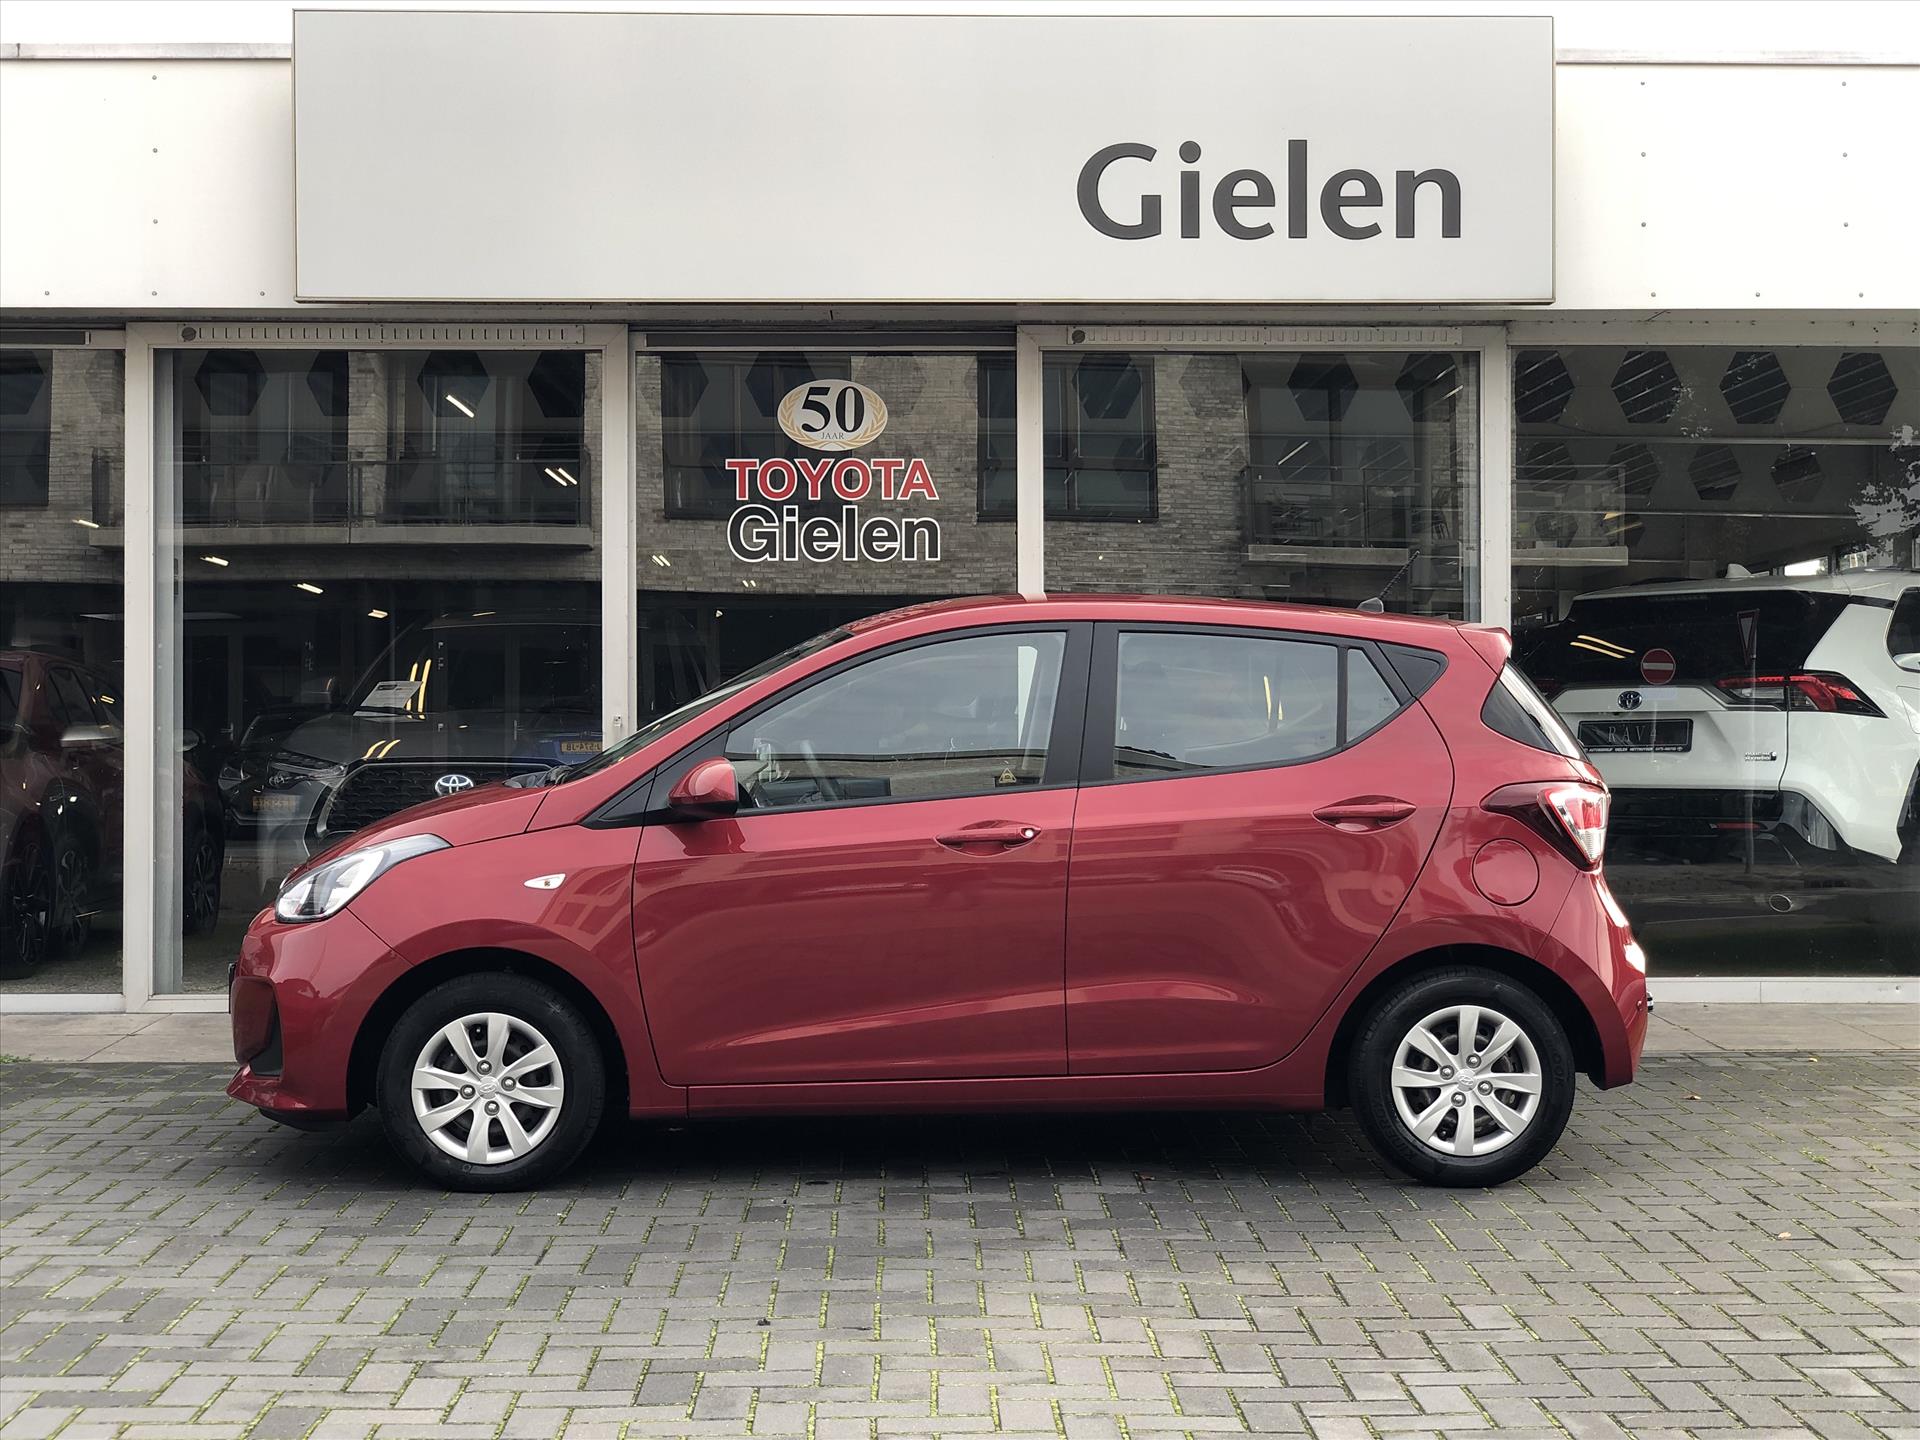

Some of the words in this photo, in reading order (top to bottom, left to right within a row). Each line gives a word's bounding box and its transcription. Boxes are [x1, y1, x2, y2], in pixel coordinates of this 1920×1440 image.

[1077, 139, 1461, 240] Gielen
[801, 386, 865, 432] 50
[820, 431, 845, 440] JAAR
[725, 458, 939, 501] TOYOTA
[727, 504, 941, 562] Gielen
